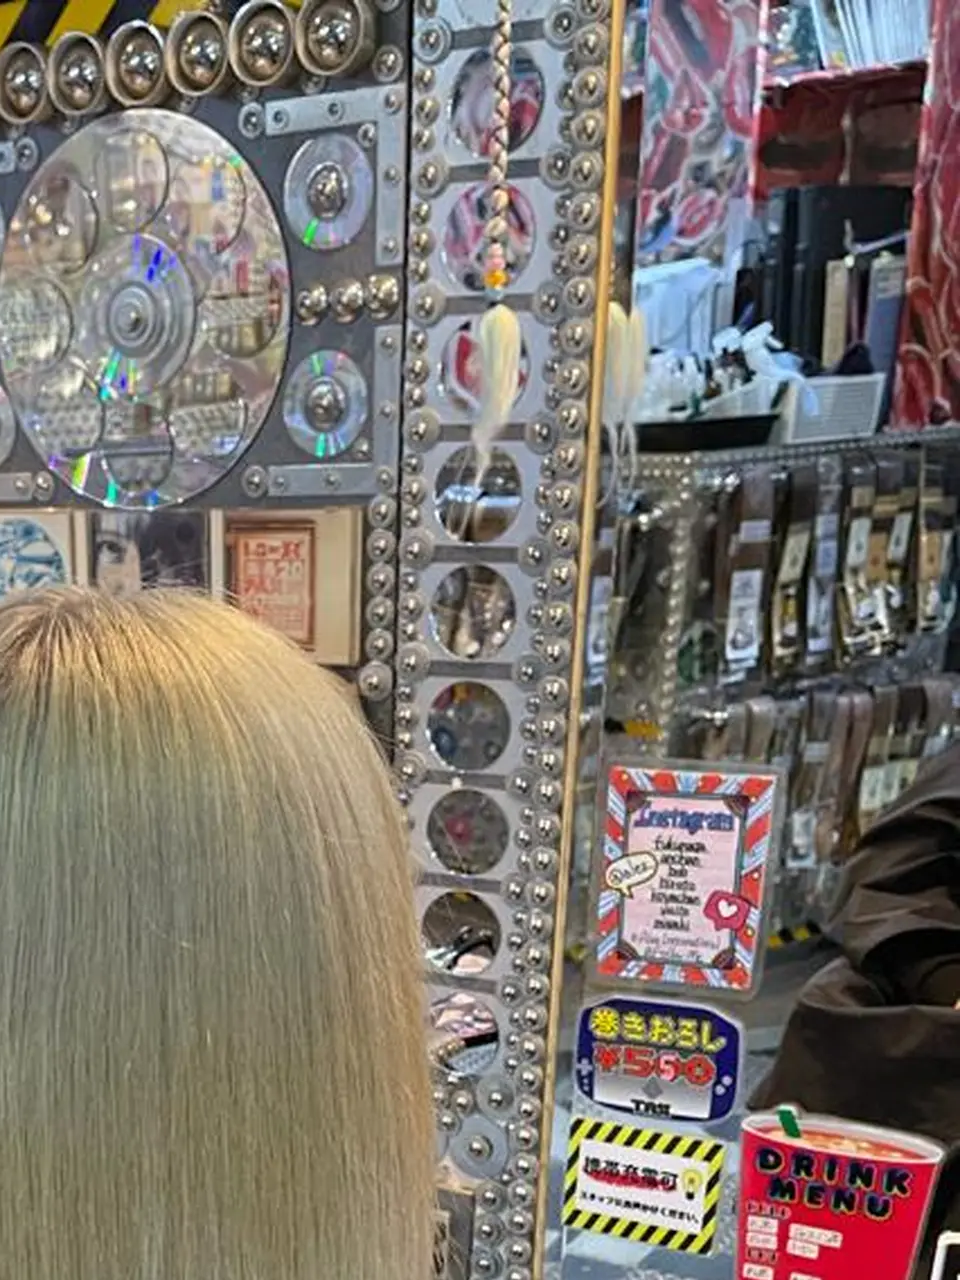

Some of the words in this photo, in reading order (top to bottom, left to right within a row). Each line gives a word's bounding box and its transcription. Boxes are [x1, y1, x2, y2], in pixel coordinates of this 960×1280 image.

[590, 1007, 728, 1053] 巻きおろし
[757, 1146, 913, 1198] DRINK
[768, 1175, 893, 1221] MENU
